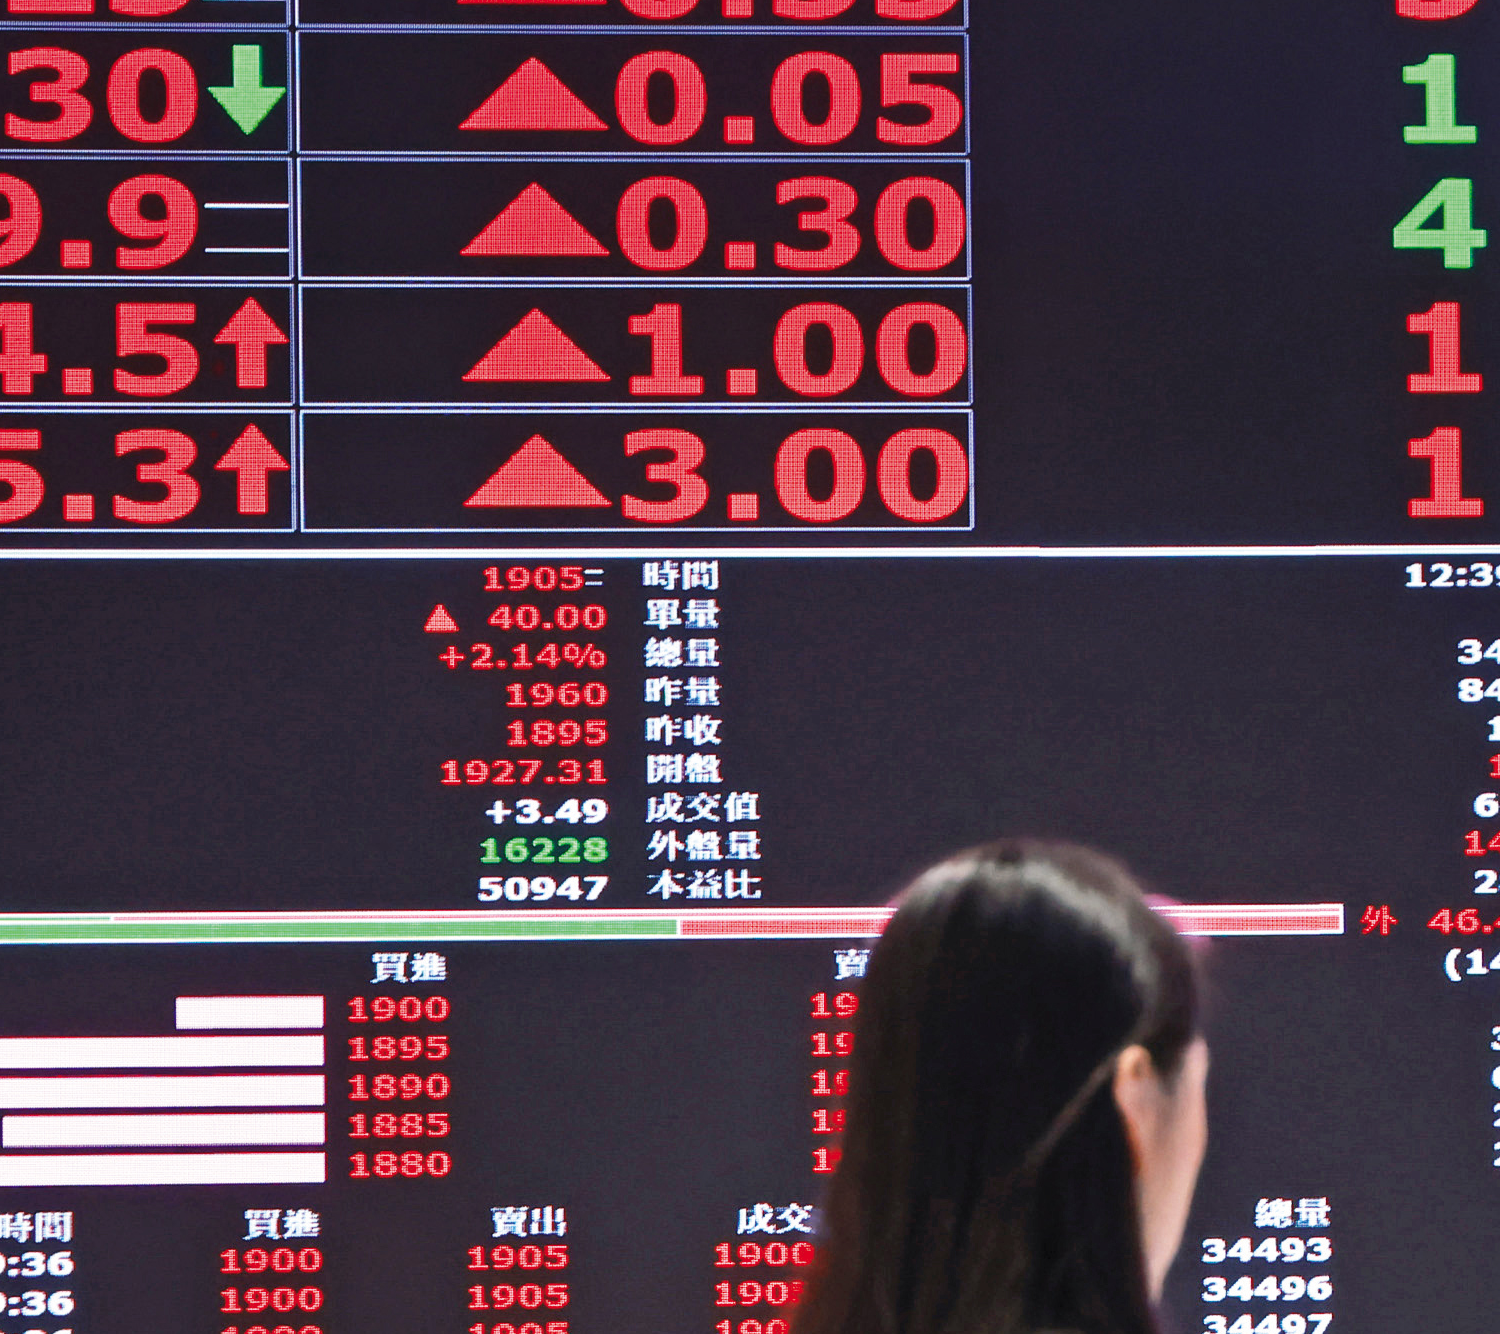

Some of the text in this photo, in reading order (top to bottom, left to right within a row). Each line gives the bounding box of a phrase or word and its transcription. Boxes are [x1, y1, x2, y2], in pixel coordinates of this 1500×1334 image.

[615, 51, 962, 145] 0.05
[1403, 54, 1477, 144] 1
[621, 428, 968, 523] 3.00
[1408, 427, 1484, 517] 1
[483, 566, 583, 591] 1905
[643, 560, 718, 590] 時間
[488, 604, 607, 630] 40.00
[644, 599, 719, 629] 單量
[506, 682, 608, 707] 1960
[507, 719, 608, 747] 1895
[646, 715, 722, 745] 昨收
[441, 759, 608, 785] 1927.31
[486, 792, 760, 824] +3.49 成交值
[480, 837, 608, 863] 16228
[478, 876, 608, 901] 50947
[647, 869, 761, 899] 本益比
[348, 996, 450, 1022] 1900
[348, 1035, 450, 1061] 1895
[349, 1151, 452, 1178] 1880
[243, 1209, 320, 1240] 買進
[1256, 1197, 1331, 1228] 總量
[220, 1248, 322, 1273] 1900
[468, 1245, 569, 1270] 1905
[1203, 1237, 1331, 1262] 34493
